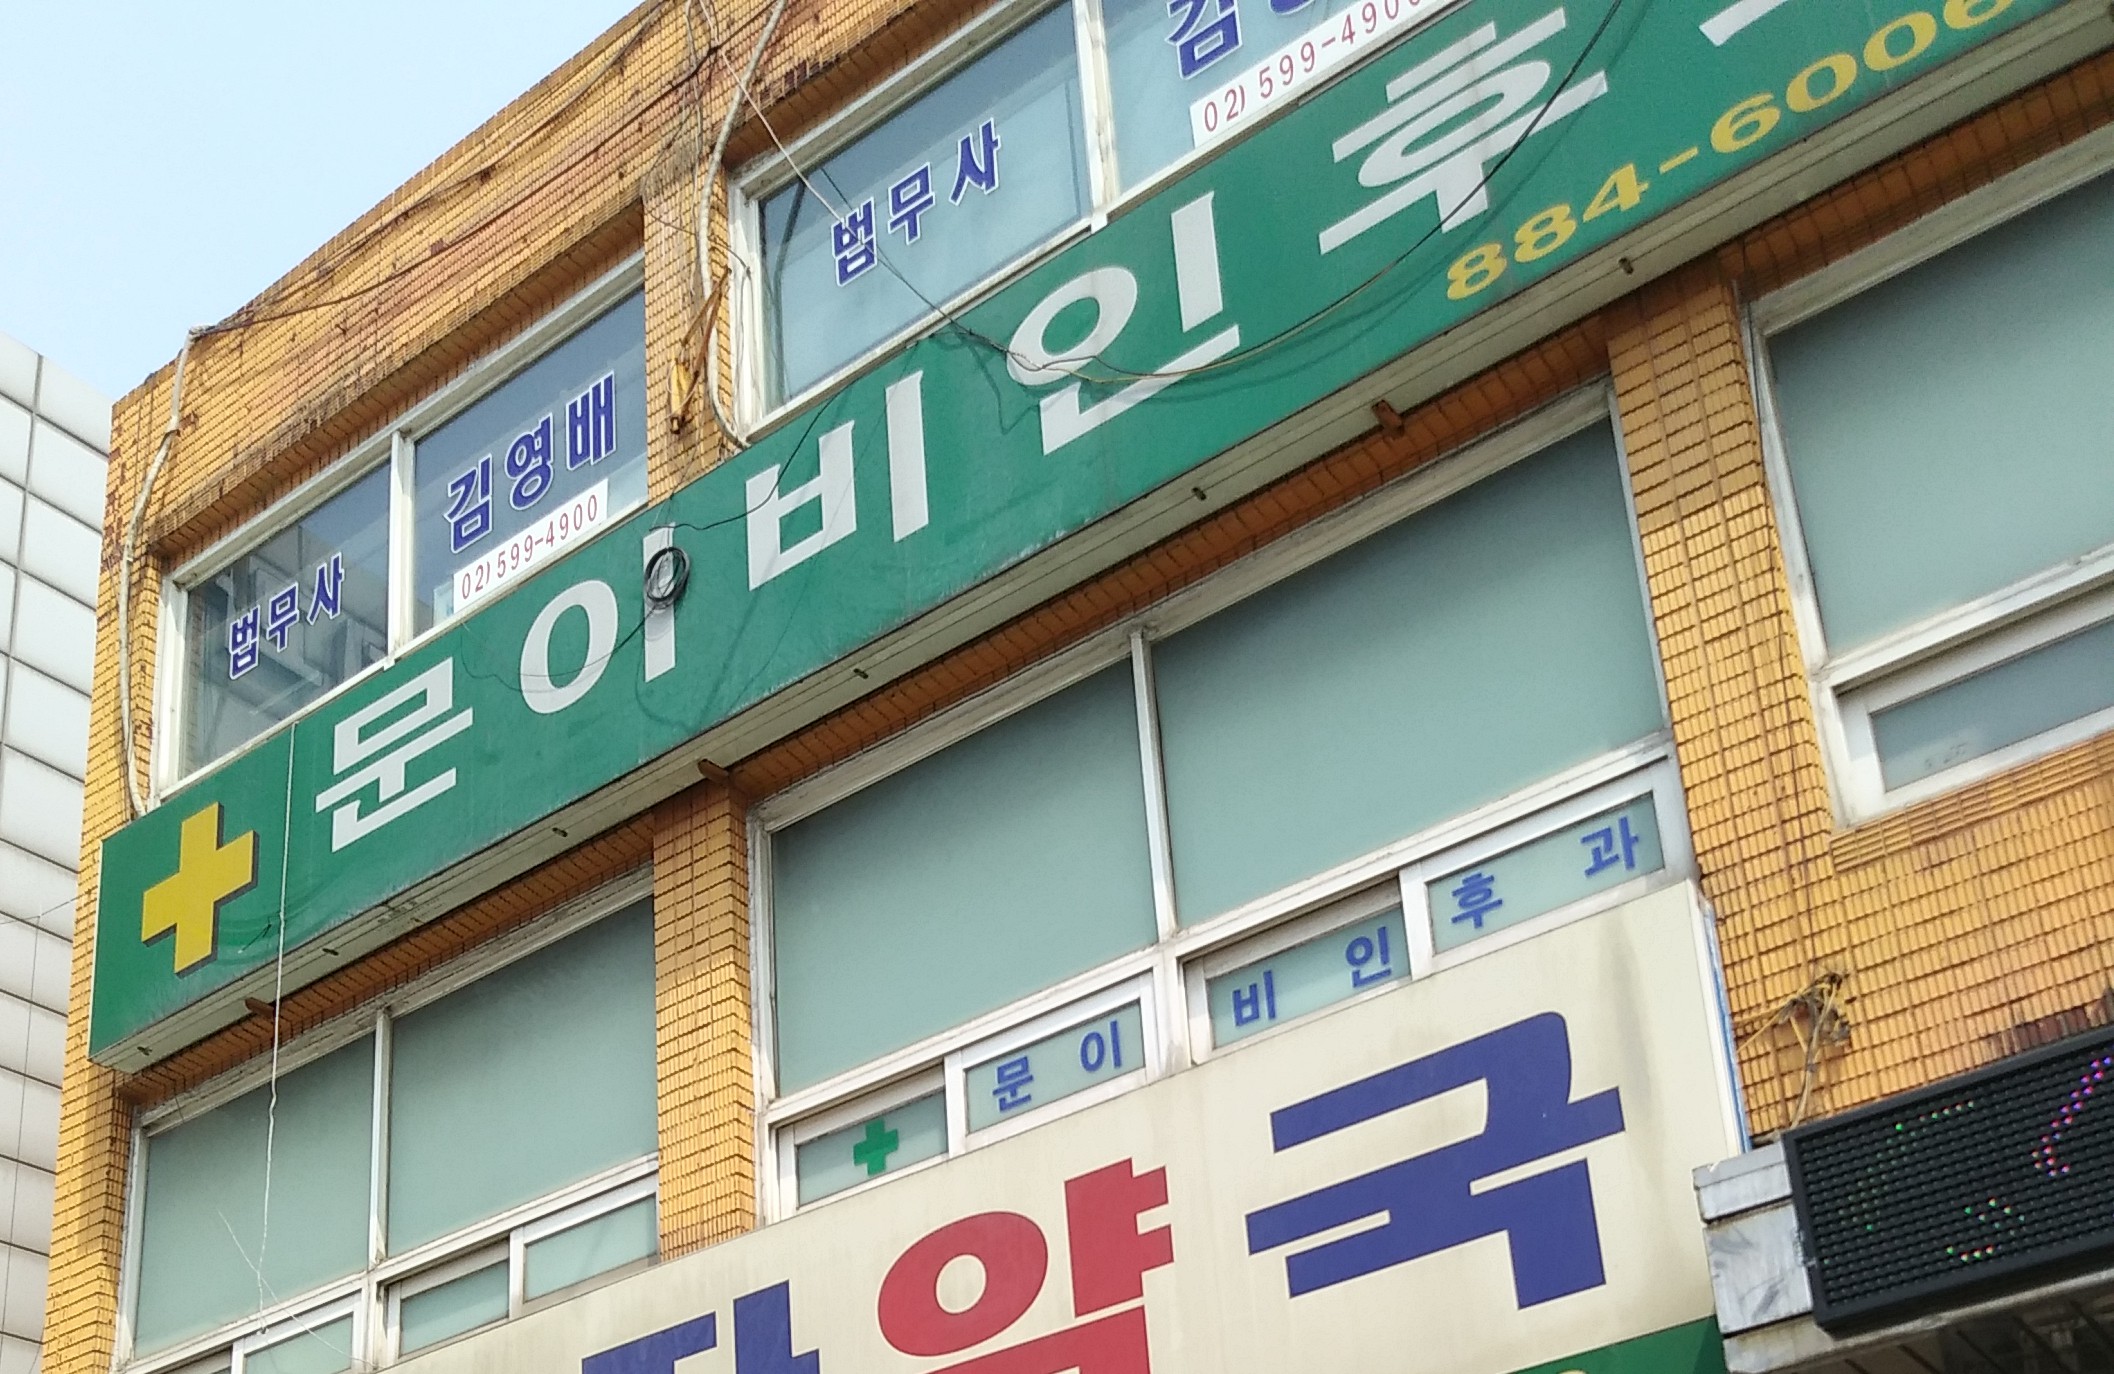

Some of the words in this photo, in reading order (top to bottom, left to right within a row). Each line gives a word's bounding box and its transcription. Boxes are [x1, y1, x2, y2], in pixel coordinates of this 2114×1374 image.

[830, 117, 1000, 286] 법무사
[444, 370, 617, 553] 김영배
[228, 551, 345, 680] 법무사
